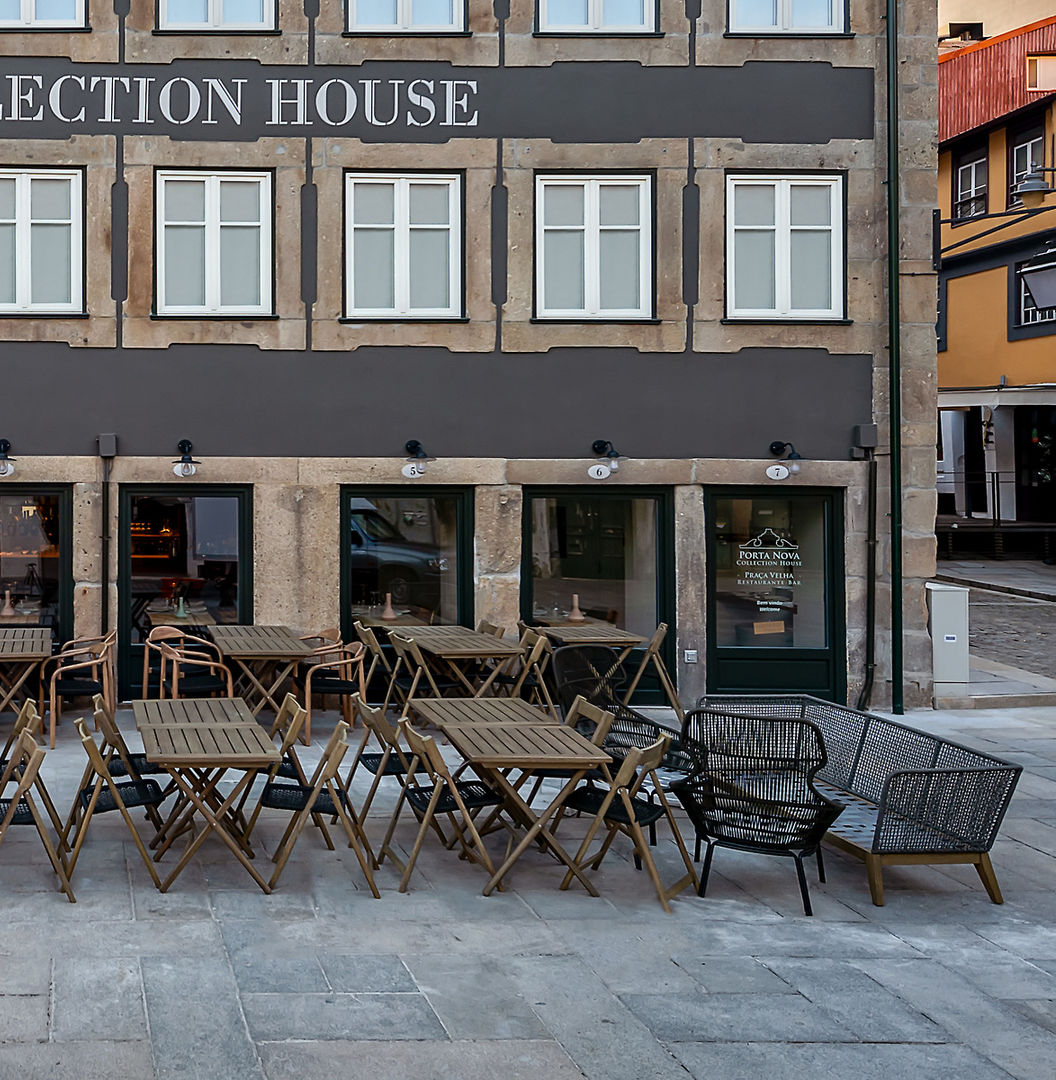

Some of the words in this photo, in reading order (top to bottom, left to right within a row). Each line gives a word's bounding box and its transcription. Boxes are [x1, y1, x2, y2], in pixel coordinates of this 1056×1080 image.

[265, 78, 479, 127] HOUSE
[410, 466, 416, 475] 5
[596, 467, 602, 476] 6
[775, 468, 780, 477] 7
[739, 551, 770, 560] PORTA
[772, 551, 800, 560] NOVA
[745, 572, 769, 580] PRAÇA
